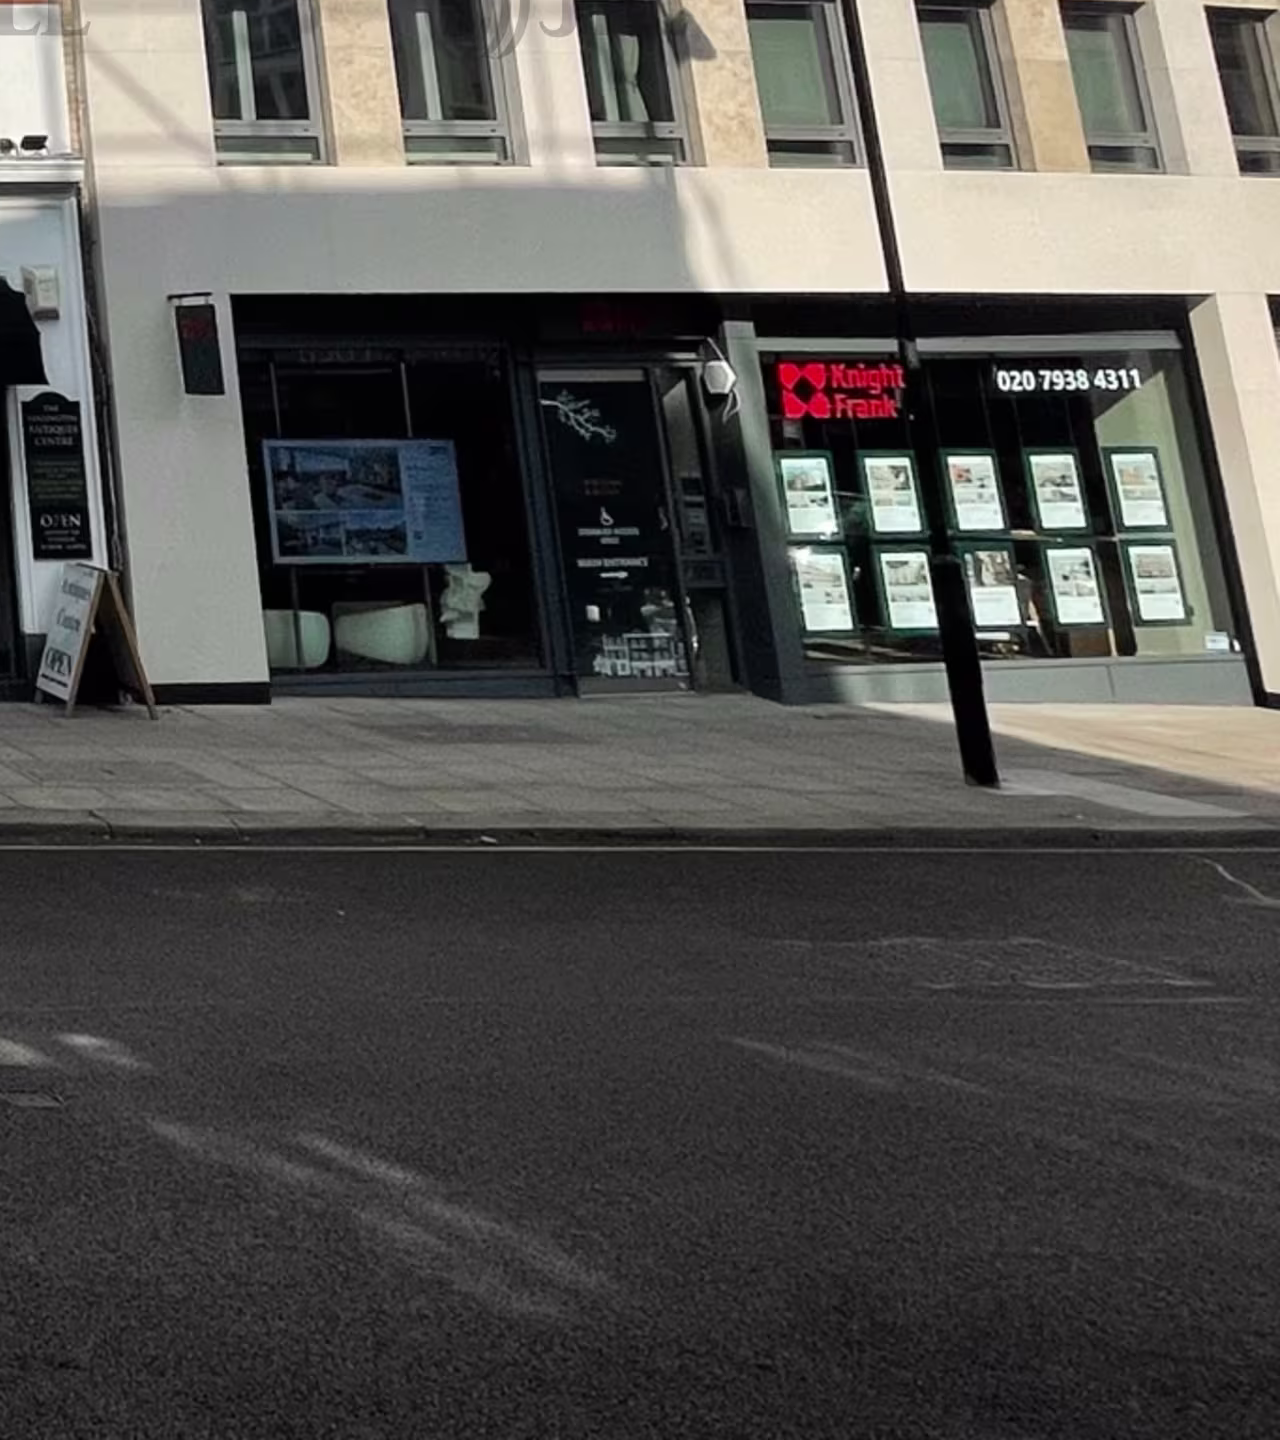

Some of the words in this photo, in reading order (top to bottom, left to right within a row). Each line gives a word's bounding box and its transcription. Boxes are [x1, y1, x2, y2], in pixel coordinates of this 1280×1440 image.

[831, 362, 907, 395] Knight
[996, 369, 1036, 392] 020
[1038, 368, 1090, 391] 7938
[1093, 367, 1143, 391] 4311
[834, 392, 898, 419] Frank
[39, 513, 82, 528] OPEN
